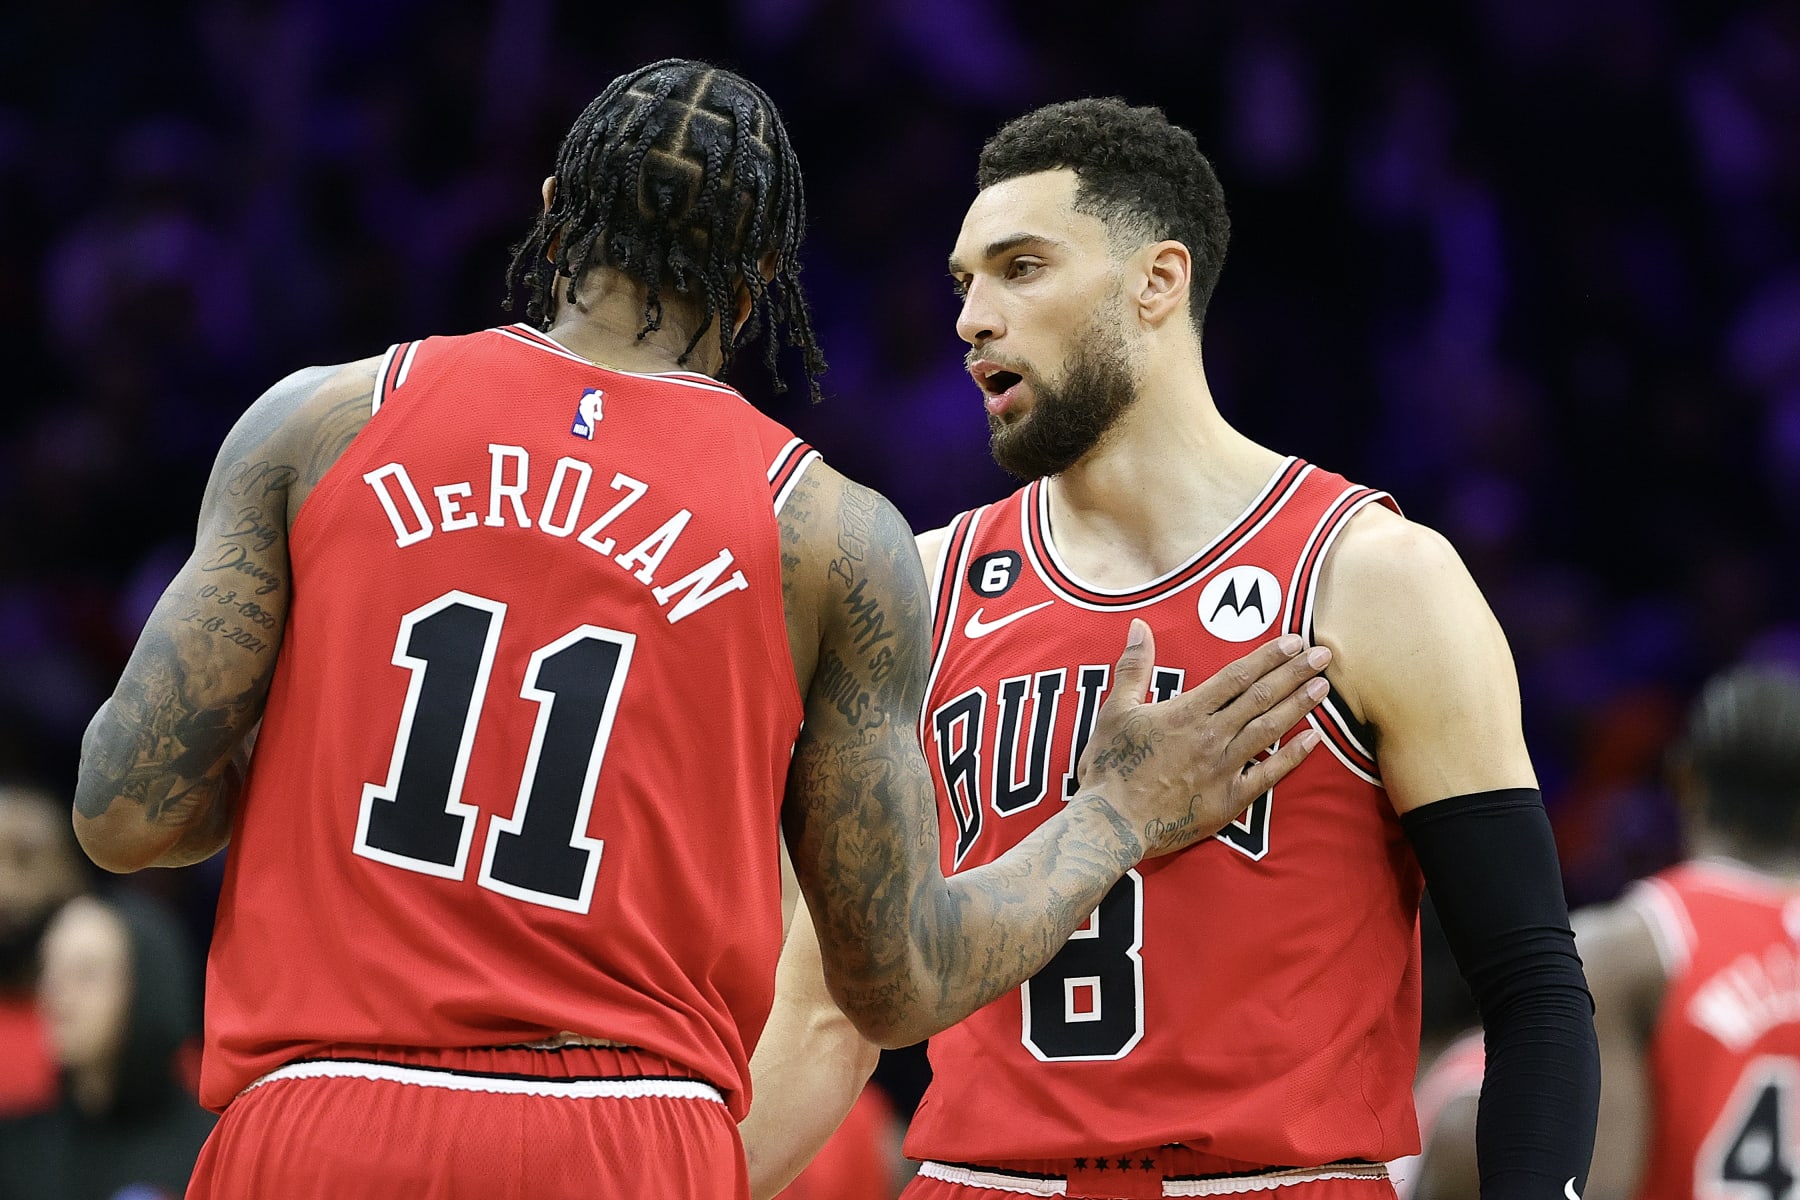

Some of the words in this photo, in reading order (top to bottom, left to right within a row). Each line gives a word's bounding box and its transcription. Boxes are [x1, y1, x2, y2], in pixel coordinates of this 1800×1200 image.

[221, 506, 279, 552] Big
[981, 556, 1012, 593] 6
[843, 578, 894, 655] WHY
[868, 645, 896, 686] SO
[352, 589, 637, 915] 11
[1020, 868, 1145, 1063] 8
